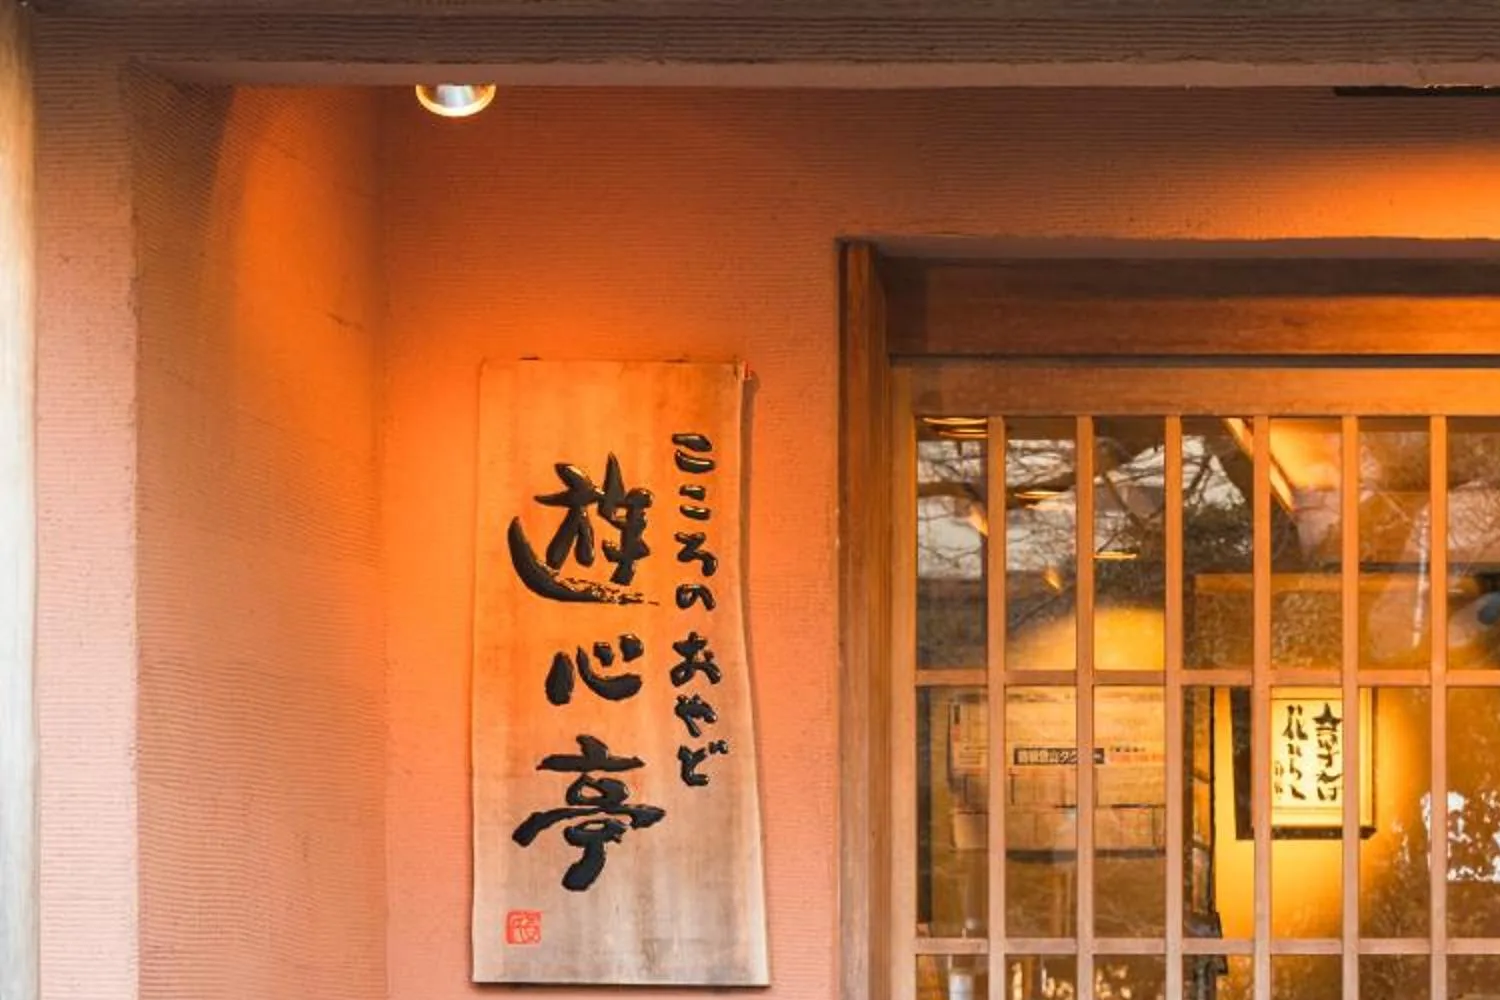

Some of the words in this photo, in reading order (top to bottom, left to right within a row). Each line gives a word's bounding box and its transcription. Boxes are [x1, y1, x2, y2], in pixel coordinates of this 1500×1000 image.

[508, 451, 665, 892] 遊心亭
[672, 432, 728, 787] こころのおやど
